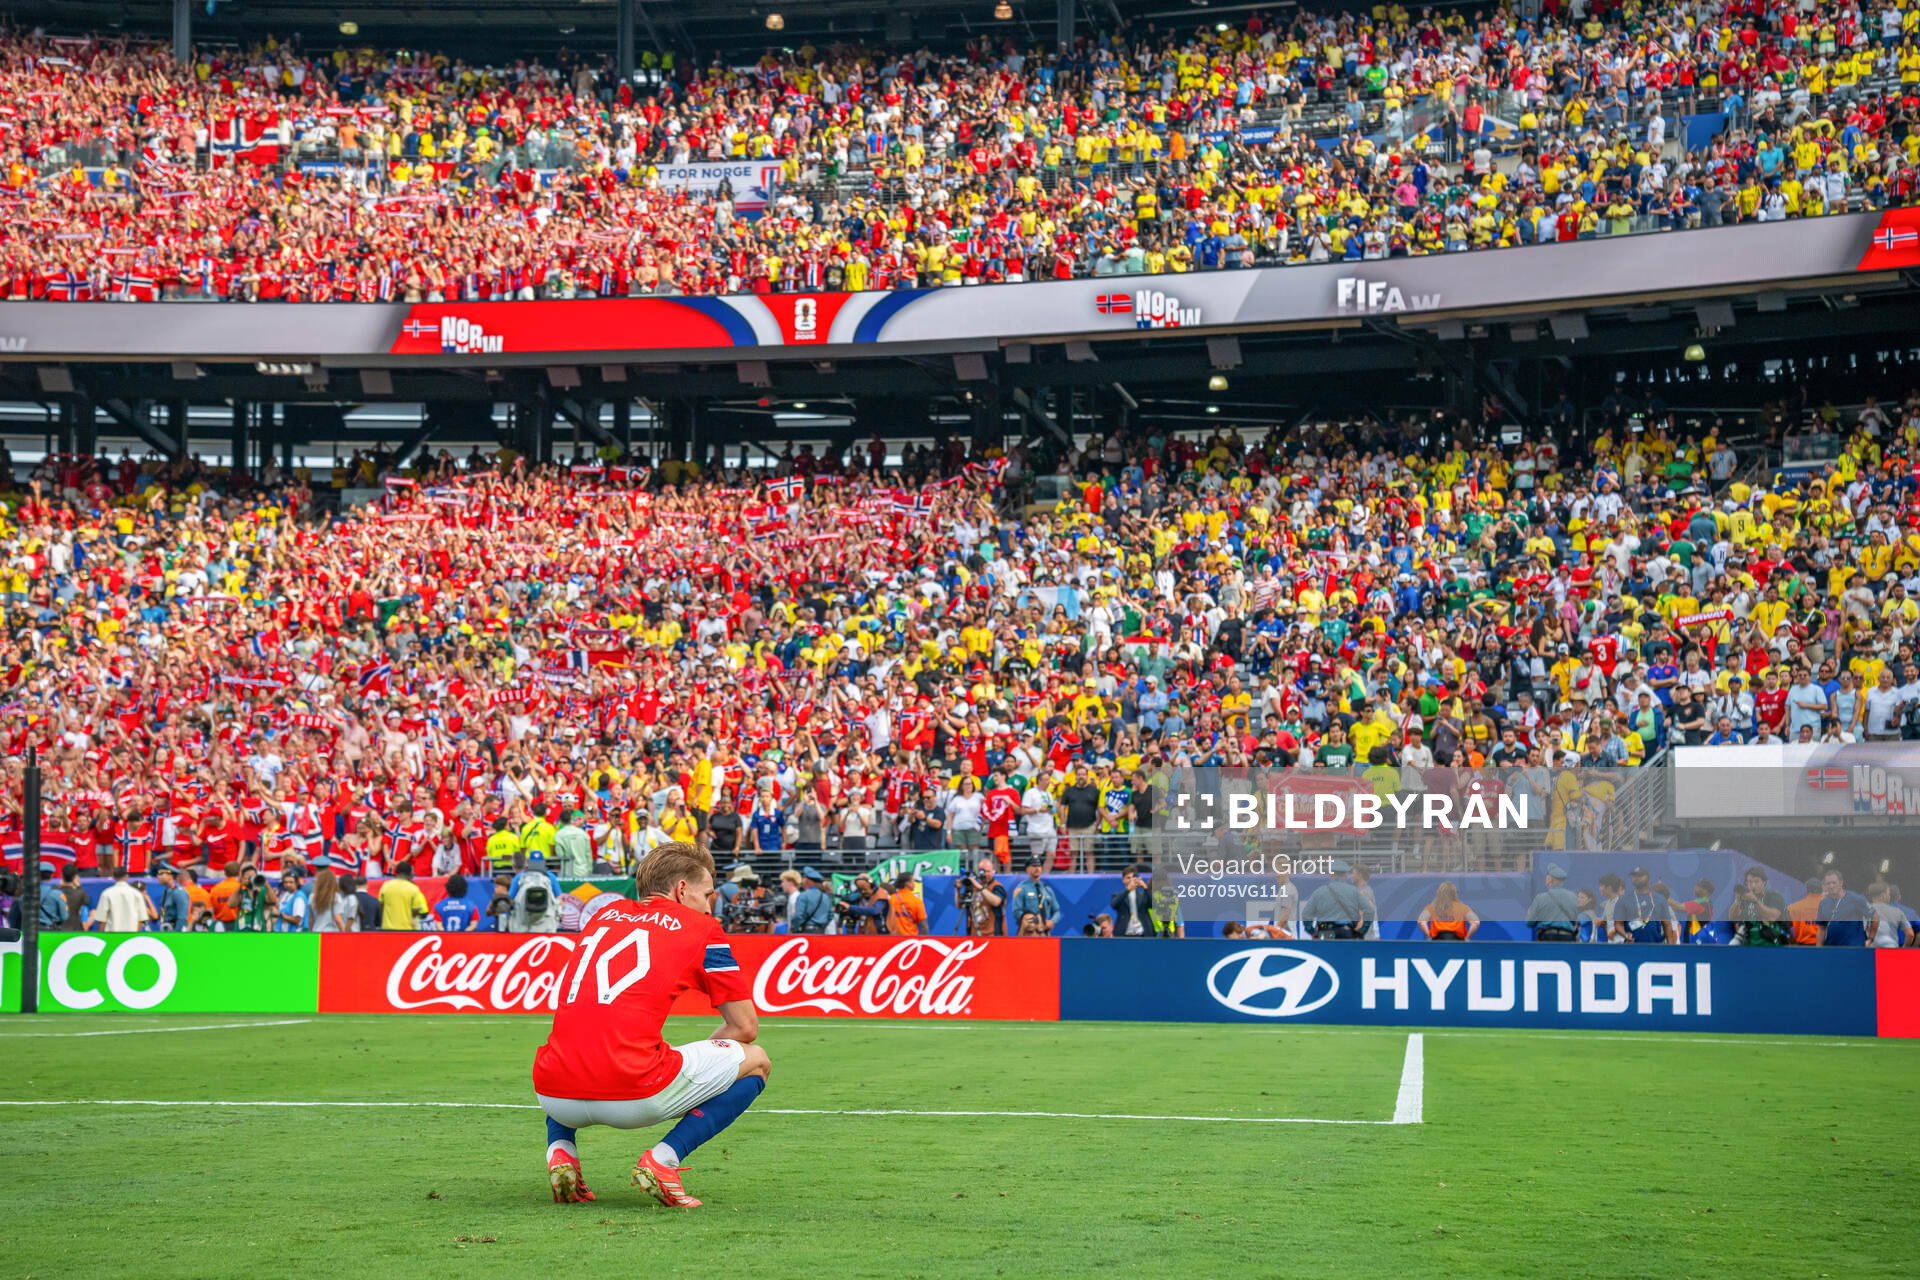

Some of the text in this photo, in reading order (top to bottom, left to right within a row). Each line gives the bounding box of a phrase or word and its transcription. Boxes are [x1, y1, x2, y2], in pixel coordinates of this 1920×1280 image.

[668, 168, 698, 179] FOR
[701, 166, 752, 179] NORGE
[1337, 277, 1408, 312] FIFA
[1678, 609, 1728, 626] NORWAY
[1597, 644, 1607, 662] 3
[567, 926, 651, 1005] 10
[753, 937, 990, 1015] Coca-Cola
[1361, 957, 1712, 1016] HYUNDAI
